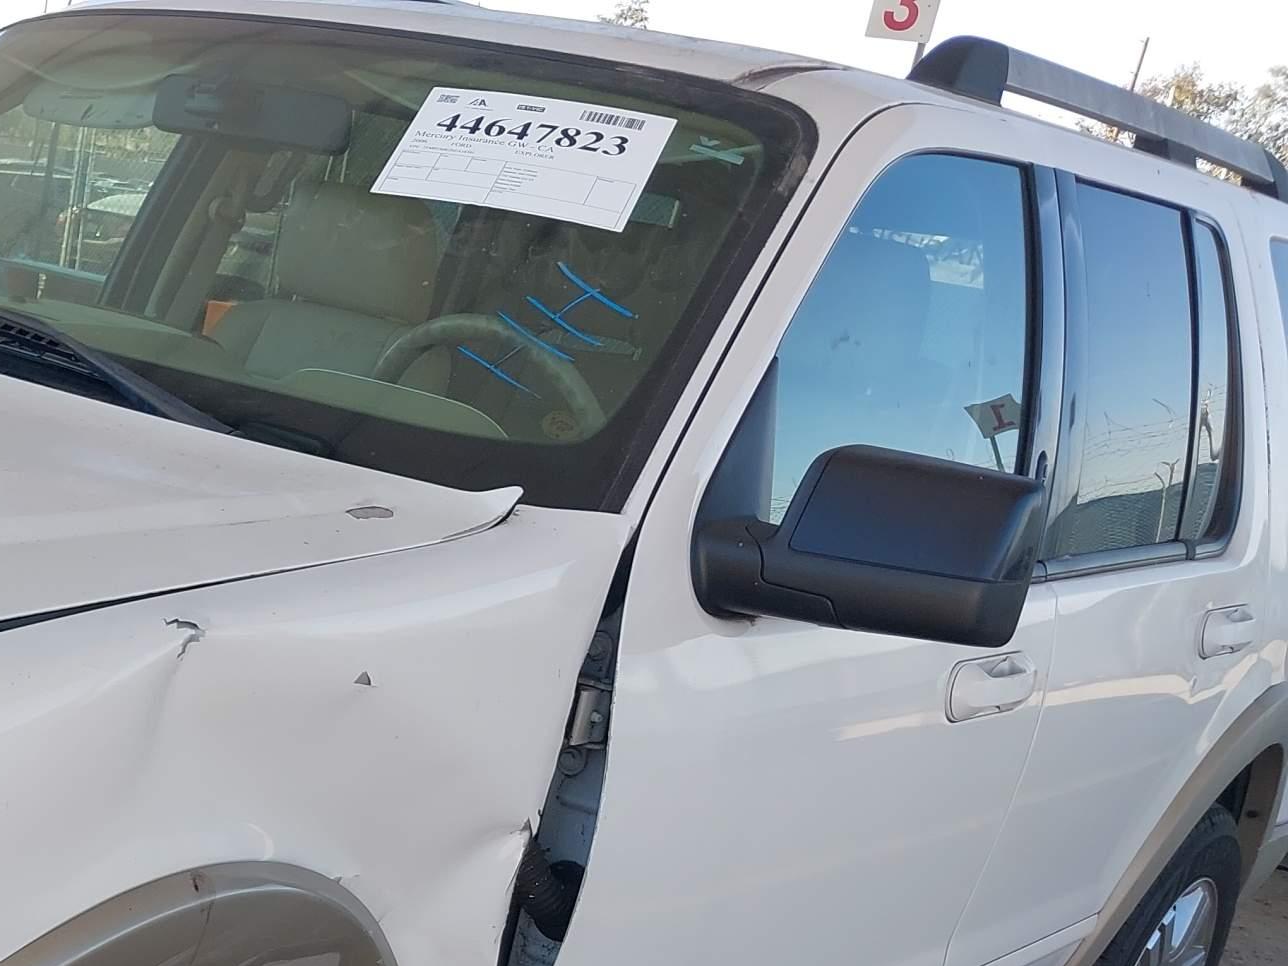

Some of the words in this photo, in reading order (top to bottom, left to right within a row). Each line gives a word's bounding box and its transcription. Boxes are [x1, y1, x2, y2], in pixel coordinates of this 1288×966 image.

[883, 0, 919, 31] 3
[415, 130, 456, 141] Mercury
[458, 134, 504, 146] Insurance
[436, 113, 629, 156] 44647823
